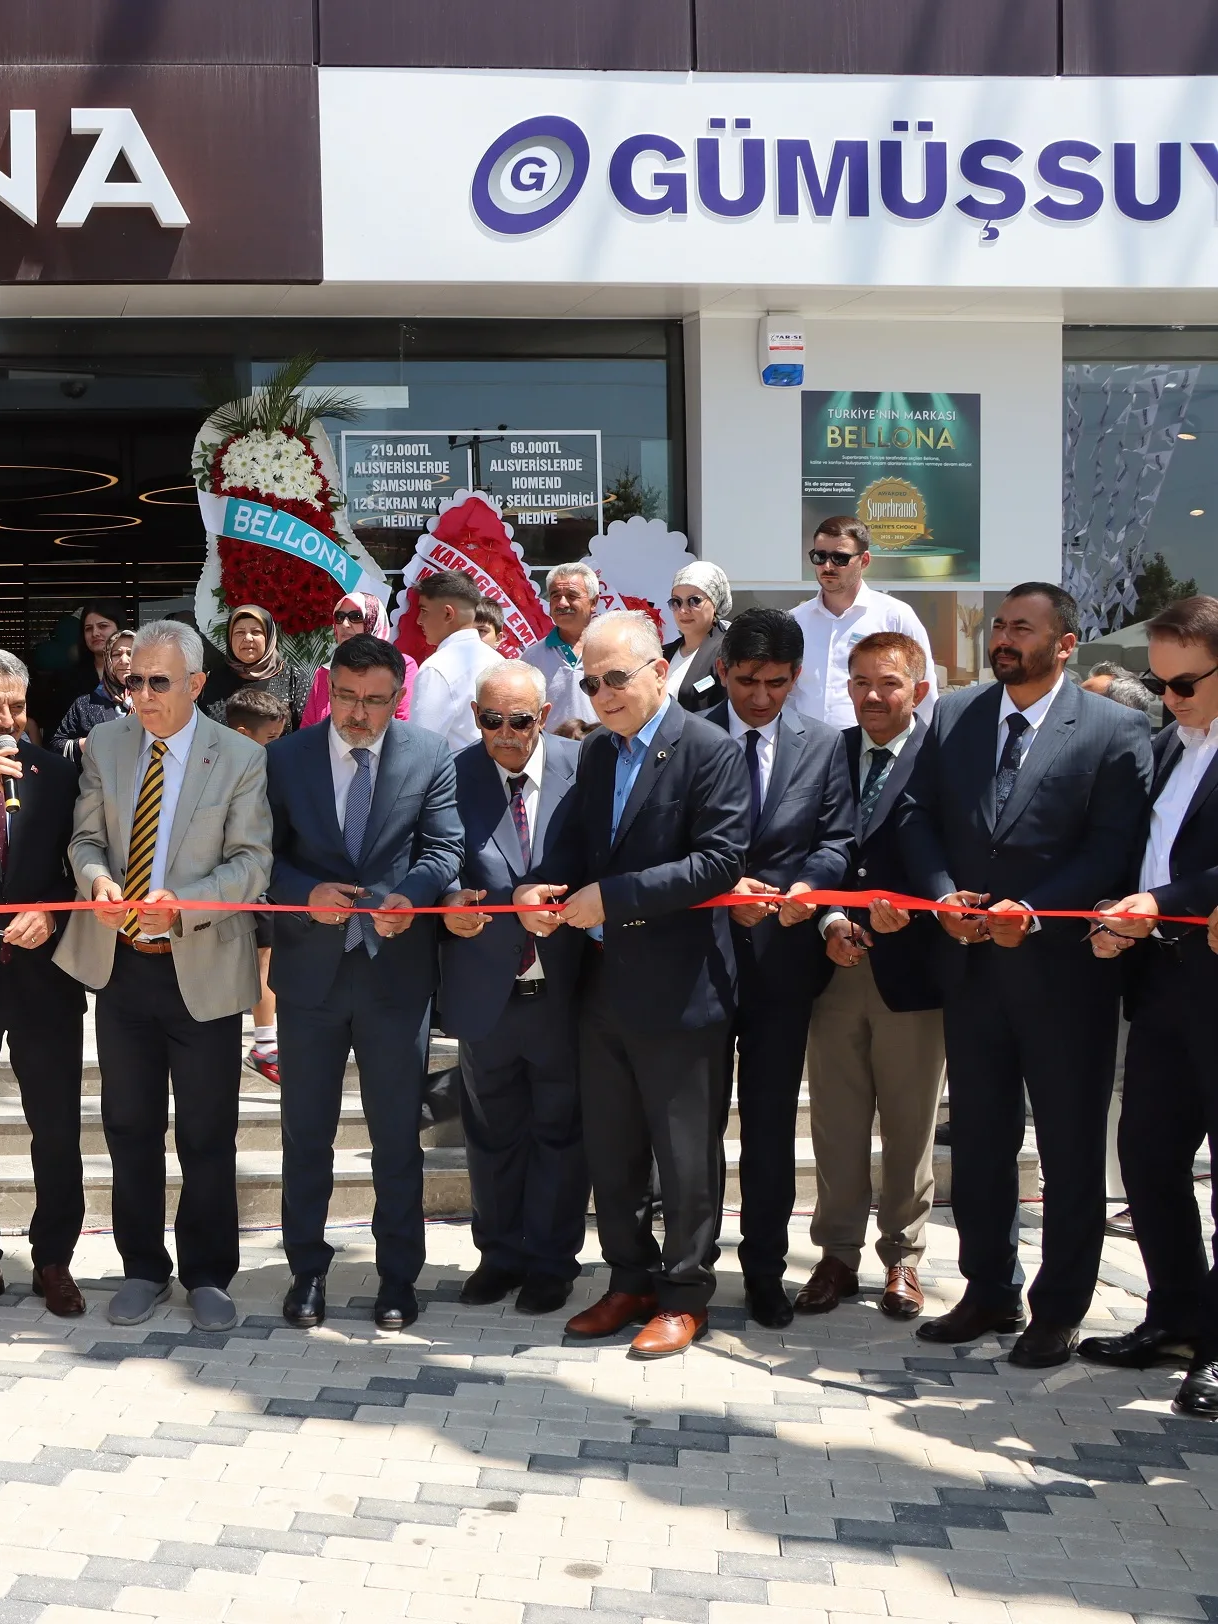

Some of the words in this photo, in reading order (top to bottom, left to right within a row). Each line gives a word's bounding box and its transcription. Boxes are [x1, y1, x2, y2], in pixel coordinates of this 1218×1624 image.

[509, 156, 547, 193] G
[827, 407, 900, 420] TÜRKİYE'NİN
[903, 410, 957, 421] MARKASI
[826, 425, 956, 450] BELLONA
[371, 443, 432, 456] 219.000TL
[510, 441, 562, 454] 69.000TL
[372, 479, 432, 492] SAMSUNG
[511, 476, 562, 490] HOMEND
[377, 497, 418, 510] EKRAN
[420, 497, 437, 510] 4K
[506, 491, 595, 509] ŞEKİLLENDİRİCİ
[517, 509, 558, 525] HEDİYE
[867, 498, 918, 521] Superbrands
[382, 512, 424, 528] HEDİYE
[233, 505, 348, 582] BELLONA
